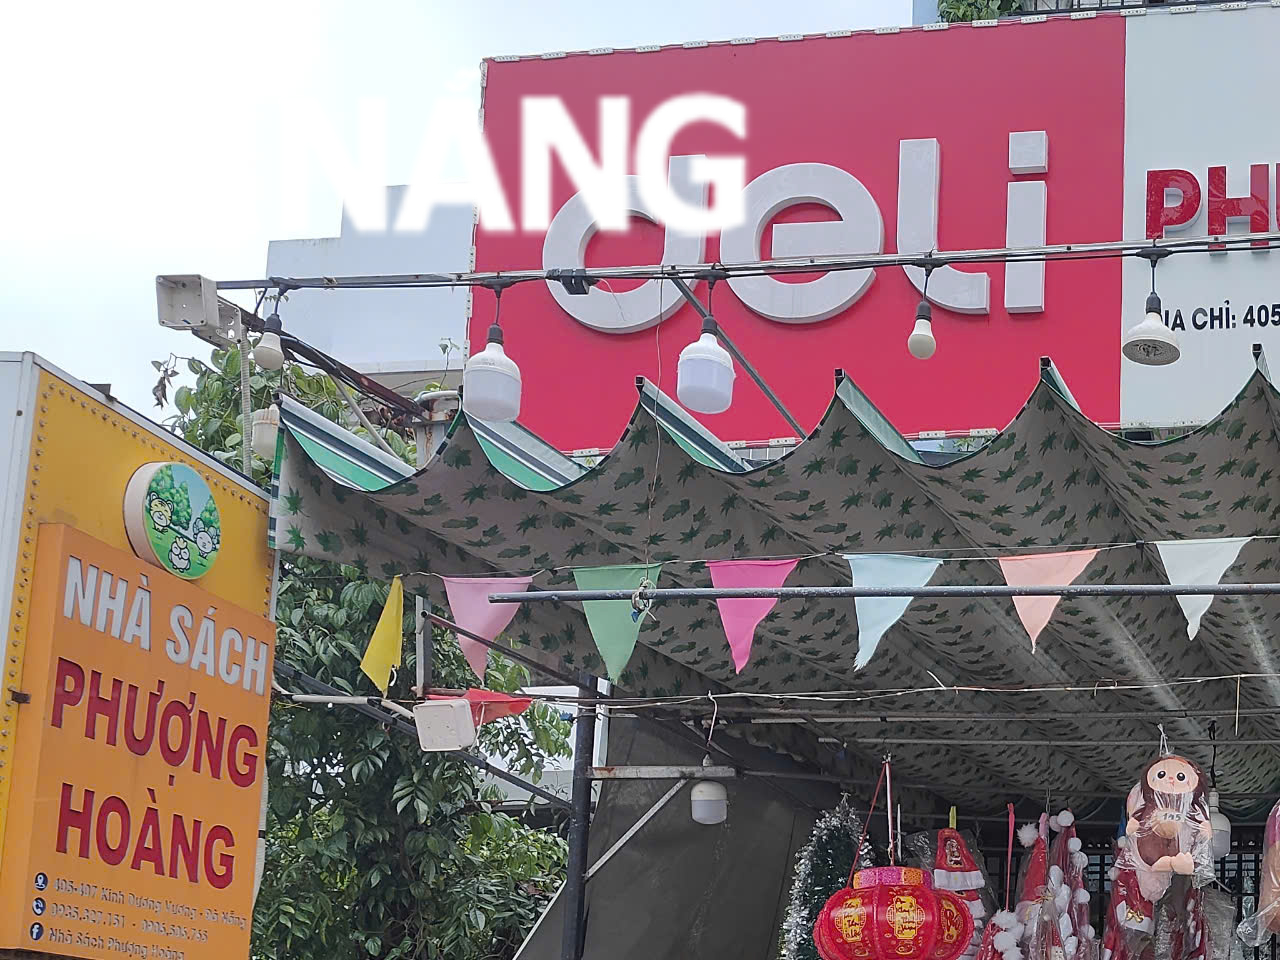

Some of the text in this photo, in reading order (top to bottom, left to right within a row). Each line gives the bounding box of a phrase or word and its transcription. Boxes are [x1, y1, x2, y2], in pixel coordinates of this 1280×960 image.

[543, 131, 1048, 334] deli
[1191, 300, 1237, 331] CHỈ:
[63, 553, 270, 697] NHÀ SÁCH
[50, 656, 260, 789] PHƯỢNG
[55, 781, 236, 890] HOÀNG
[49, 927, 73, 945] Nhà
[76, 929, 105, 950] Sách
[101, 887, 126, 905] Kinh
